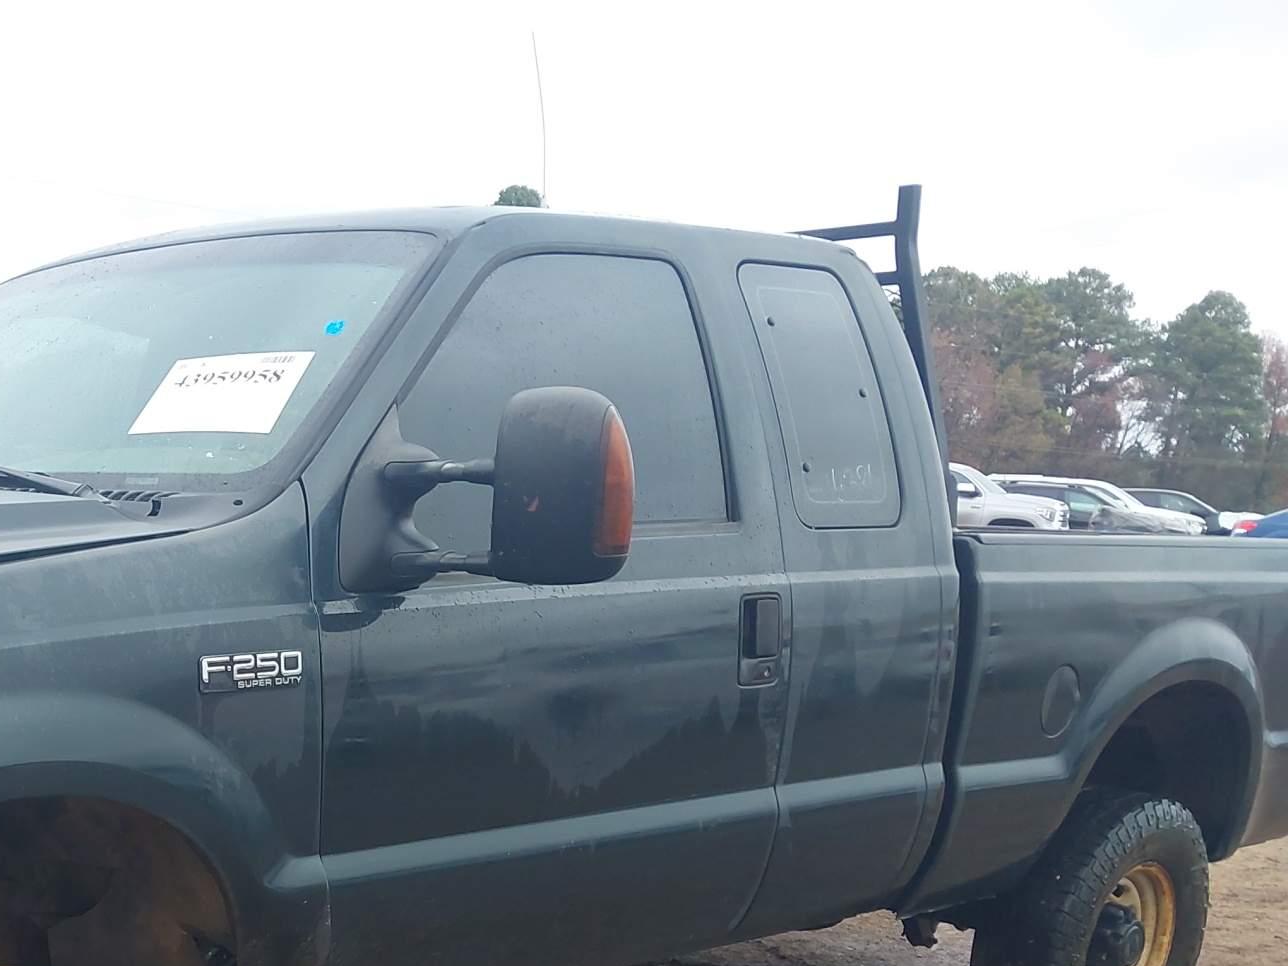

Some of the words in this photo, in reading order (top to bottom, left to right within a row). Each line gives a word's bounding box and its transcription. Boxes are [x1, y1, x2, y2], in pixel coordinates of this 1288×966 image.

[175, 369, 285, 387] 43959958
[238, 680, 272, 688] SUPER
[276, 677, 302, 685] DUTY
